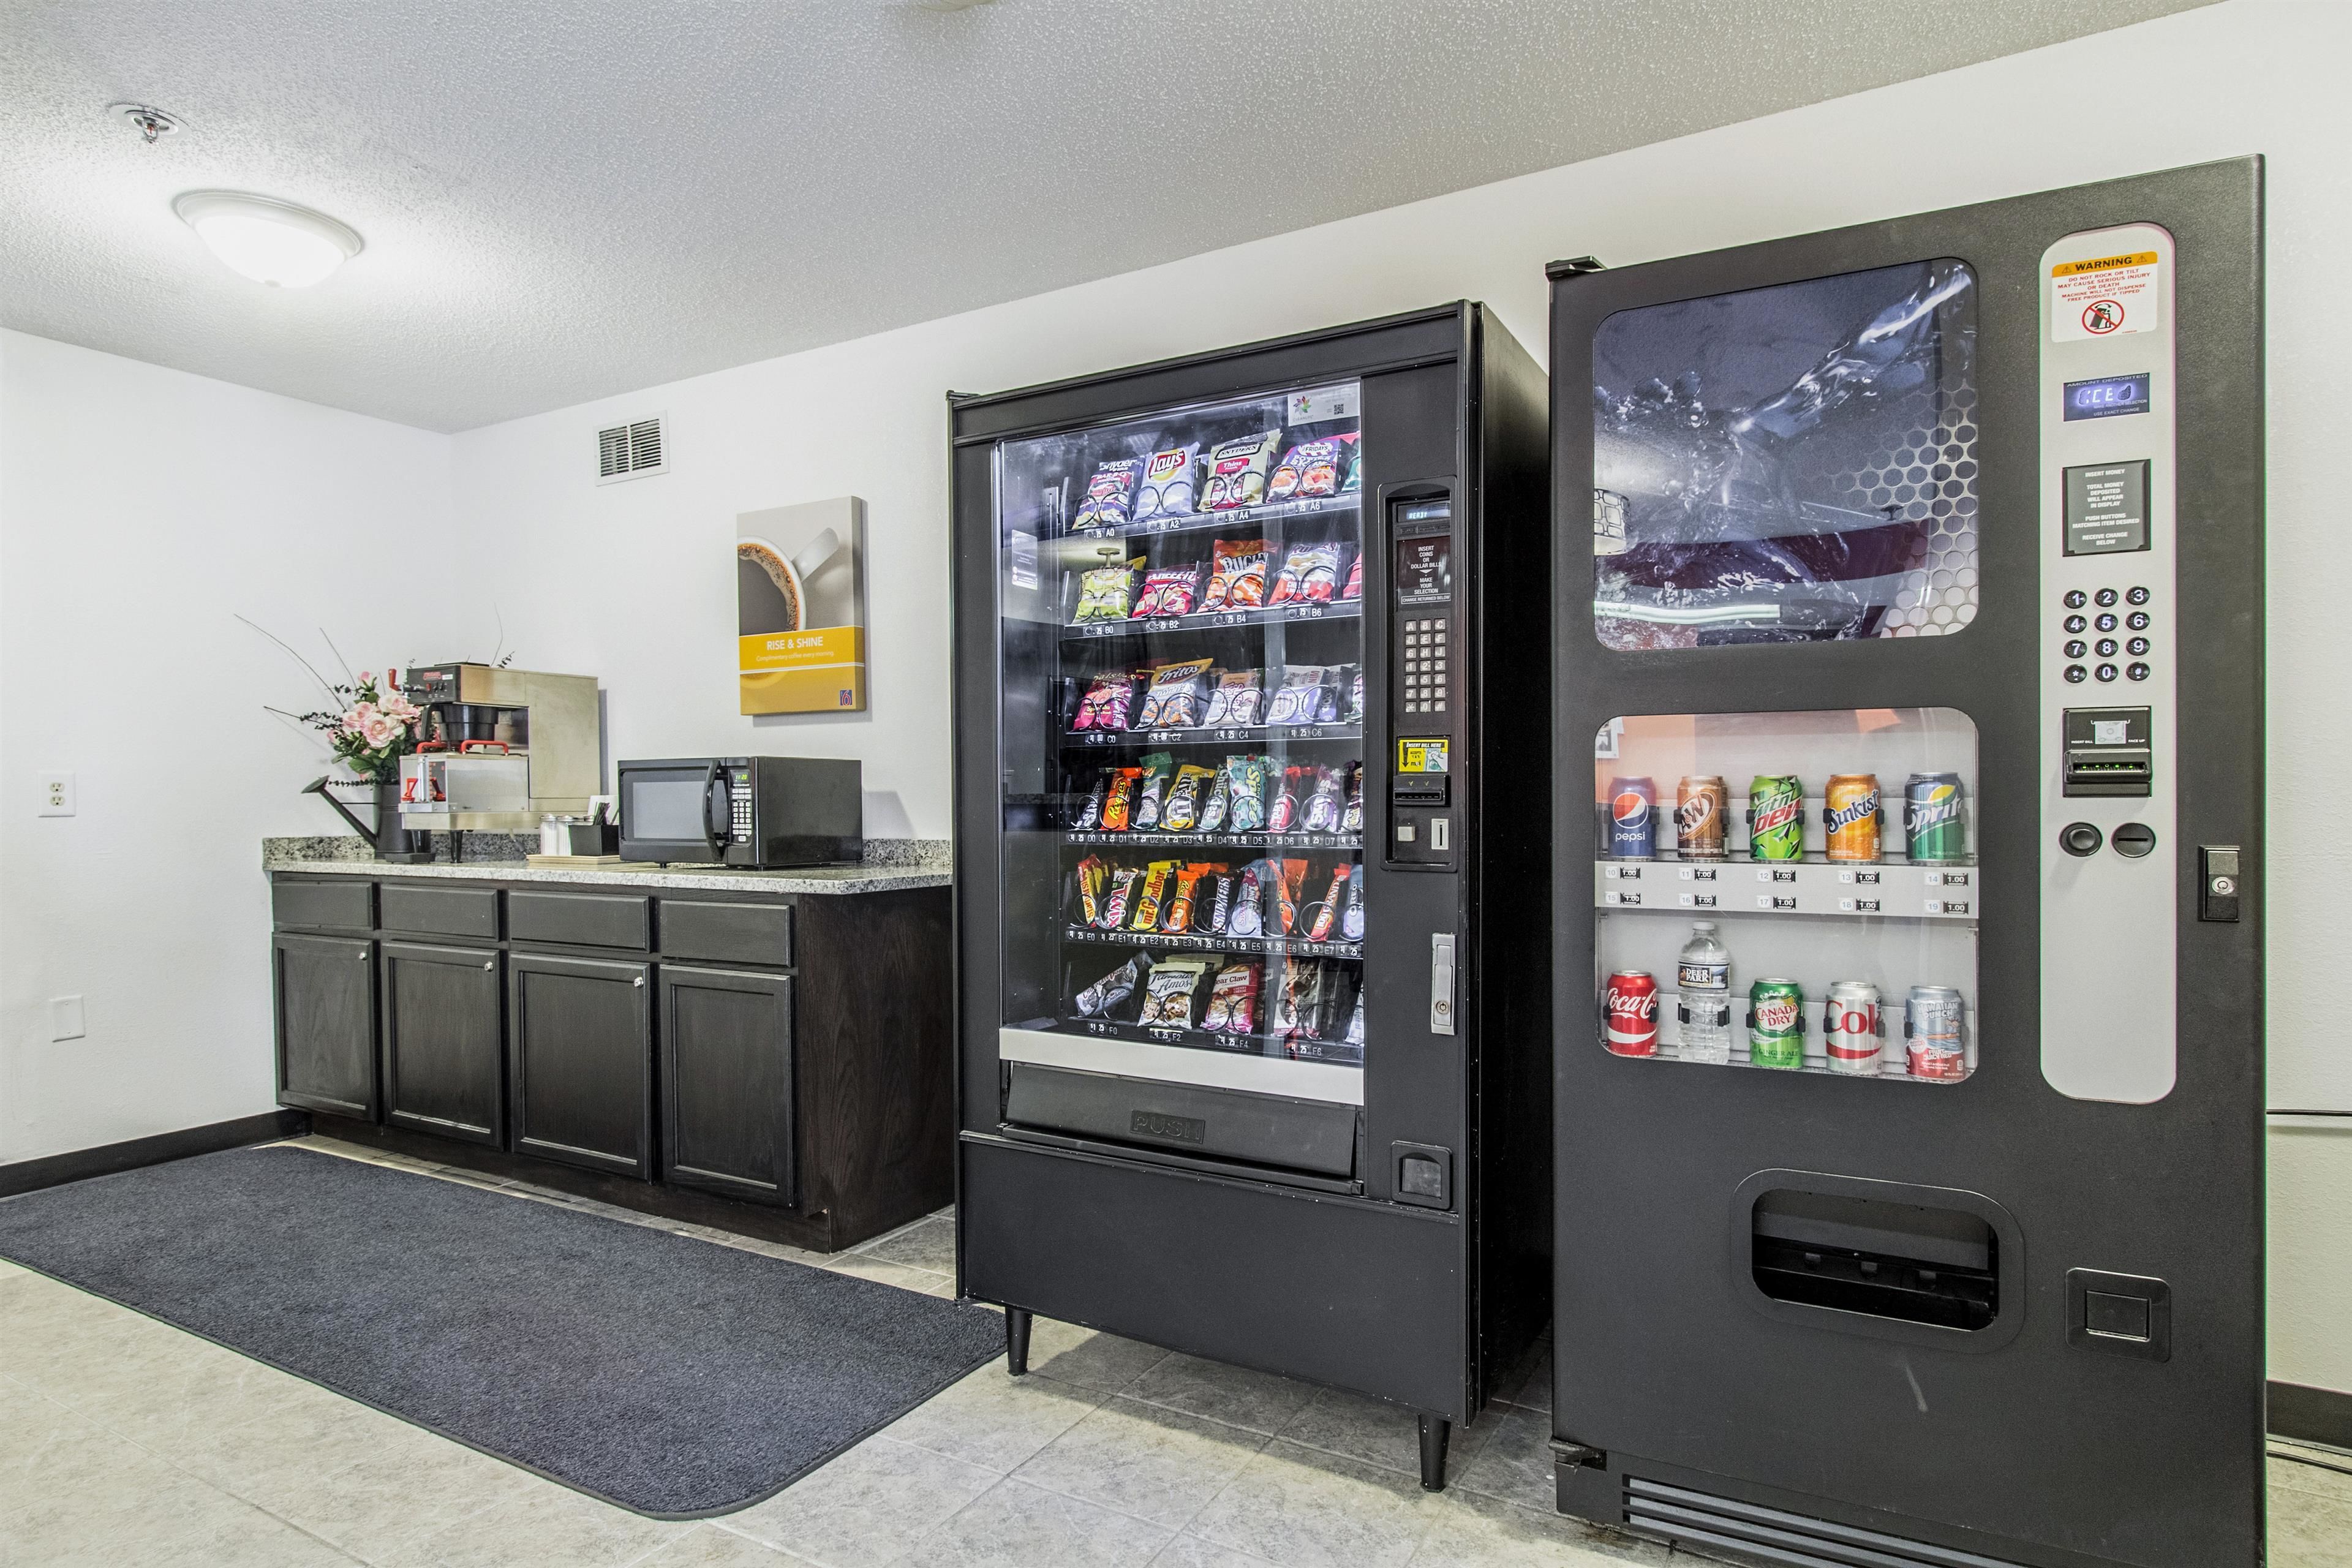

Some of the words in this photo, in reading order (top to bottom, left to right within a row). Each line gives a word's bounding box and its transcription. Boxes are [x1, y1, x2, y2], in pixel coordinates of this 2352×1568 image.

[2075, 257, 2132, 271] WARNING
[2102, 374, 2147, 383] DEPOSITED
[1310, 502, 1320, 510] A6
[1106, 529, 1115, 537] A0
[2073, 594, 2079, 605] 1
[2103, 592, 2111, 603] 2
[2134, 590, 2144, 601] 3
[1312, 608, 1322, 617] B6
[2071, 618, 2080, 630] 4
[2101, 617, 2111, 628] 5
[2134, 615, 2144, 627] 6
[767, 639, 785, 650] RISE
[788, 639, 794, 649] &
[797, 636, 823, 648] SHINE
[2072, 643, 2080, 655] 7
[2103, 642, 2111, 654] 8
[2134, 640, 2144, 652] 9
[1158, 665, 1200, 684] Fritos
[2102, 667, 2111, 678] 0
[842, 690, 851, 706] 6
[1828, 789, 1879, 834] Sunkist
[1615, 832, 1645, 842] pepsi
[1107, 883, 1128, 927] TWIX
[1349, 884, 1357, 916] OREO
[1216, 940, 1225, 949] E4
[1148, 973, 1193, 986] Famous
[1156, 979, 1191, 993] Amos
[1755, 1003, 1799, 1020] CANADA
[1916, 1003, 1958, 1014] HAWAIIAN
[1924, 1009, 1953, 1019] PUNCH
[1768, 1015, 1790, 1026] DRY
[1134, 1116, 1199, 1139] PUSH
